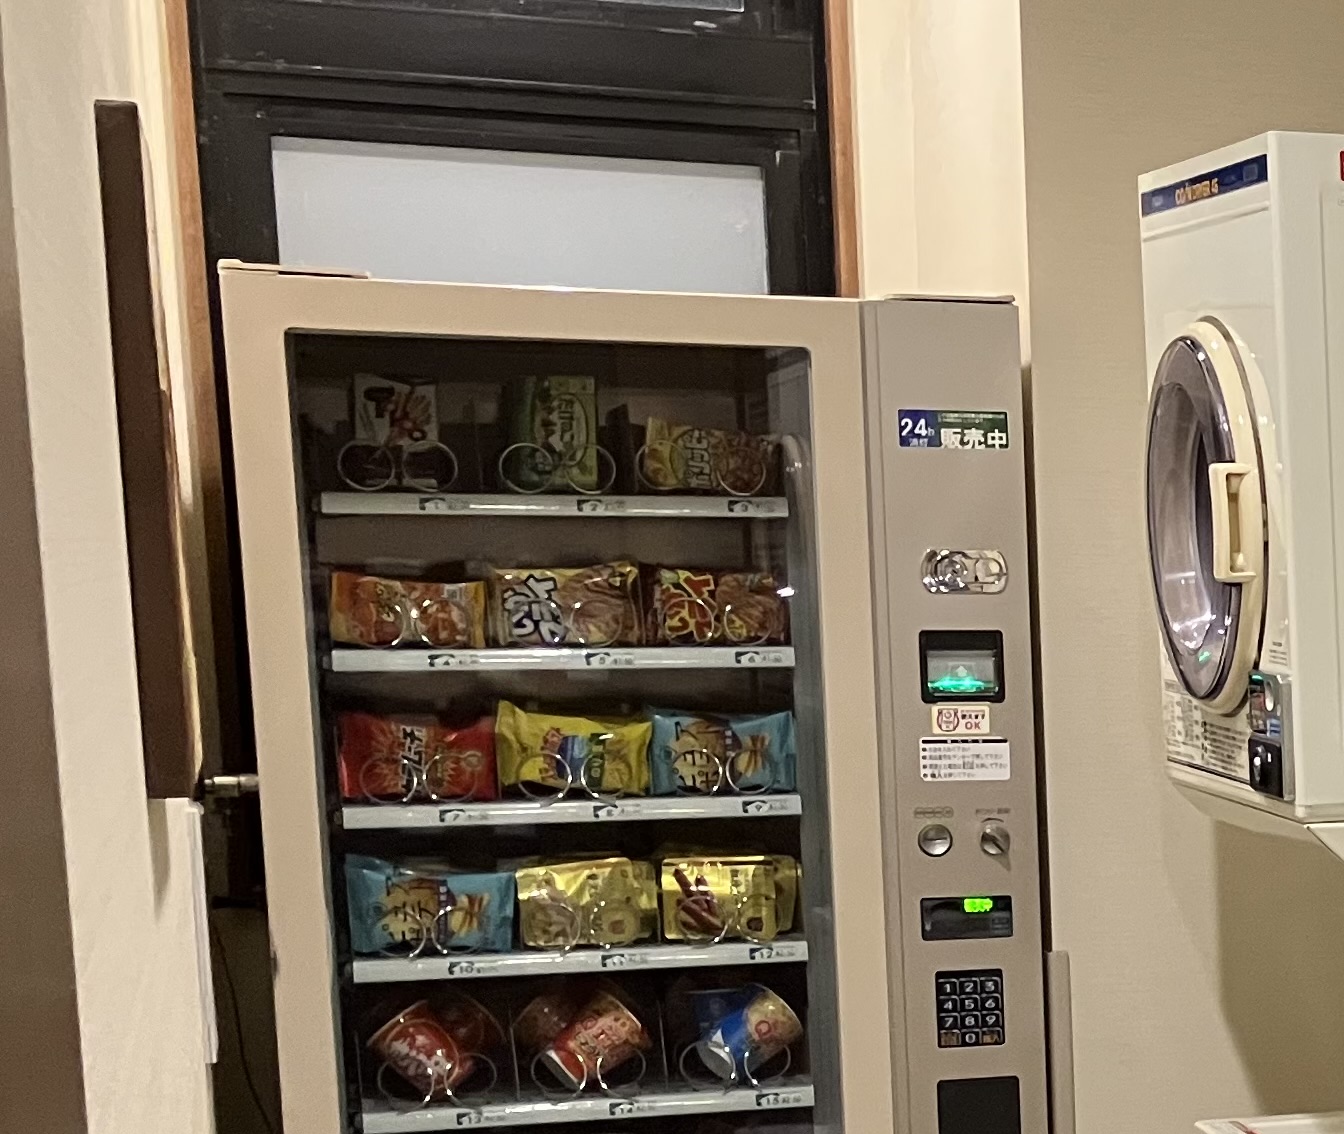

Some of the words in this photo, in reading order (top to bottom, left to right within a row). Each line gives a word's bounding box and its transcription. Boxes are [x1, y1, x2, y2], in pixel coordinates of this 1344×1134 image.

[941, 428, 1007, 449] 販売中
[965, 721, 981, 730] OK
[944, 983, 951, 993] 1
[964, 982, 974, 992] 2
[985, 981, 995, 992] 3
[943, 1000, 953, 1010] 4
[964, 999, 975, 1010] 5
[985, 998, 996, 1008] 6
[944, 1017, 954, 1028] 7
[965, 1016, 975, 1026] 8
[985, 1015, 996, 1025] 9
[965, 1033, 976, 1044] 0
